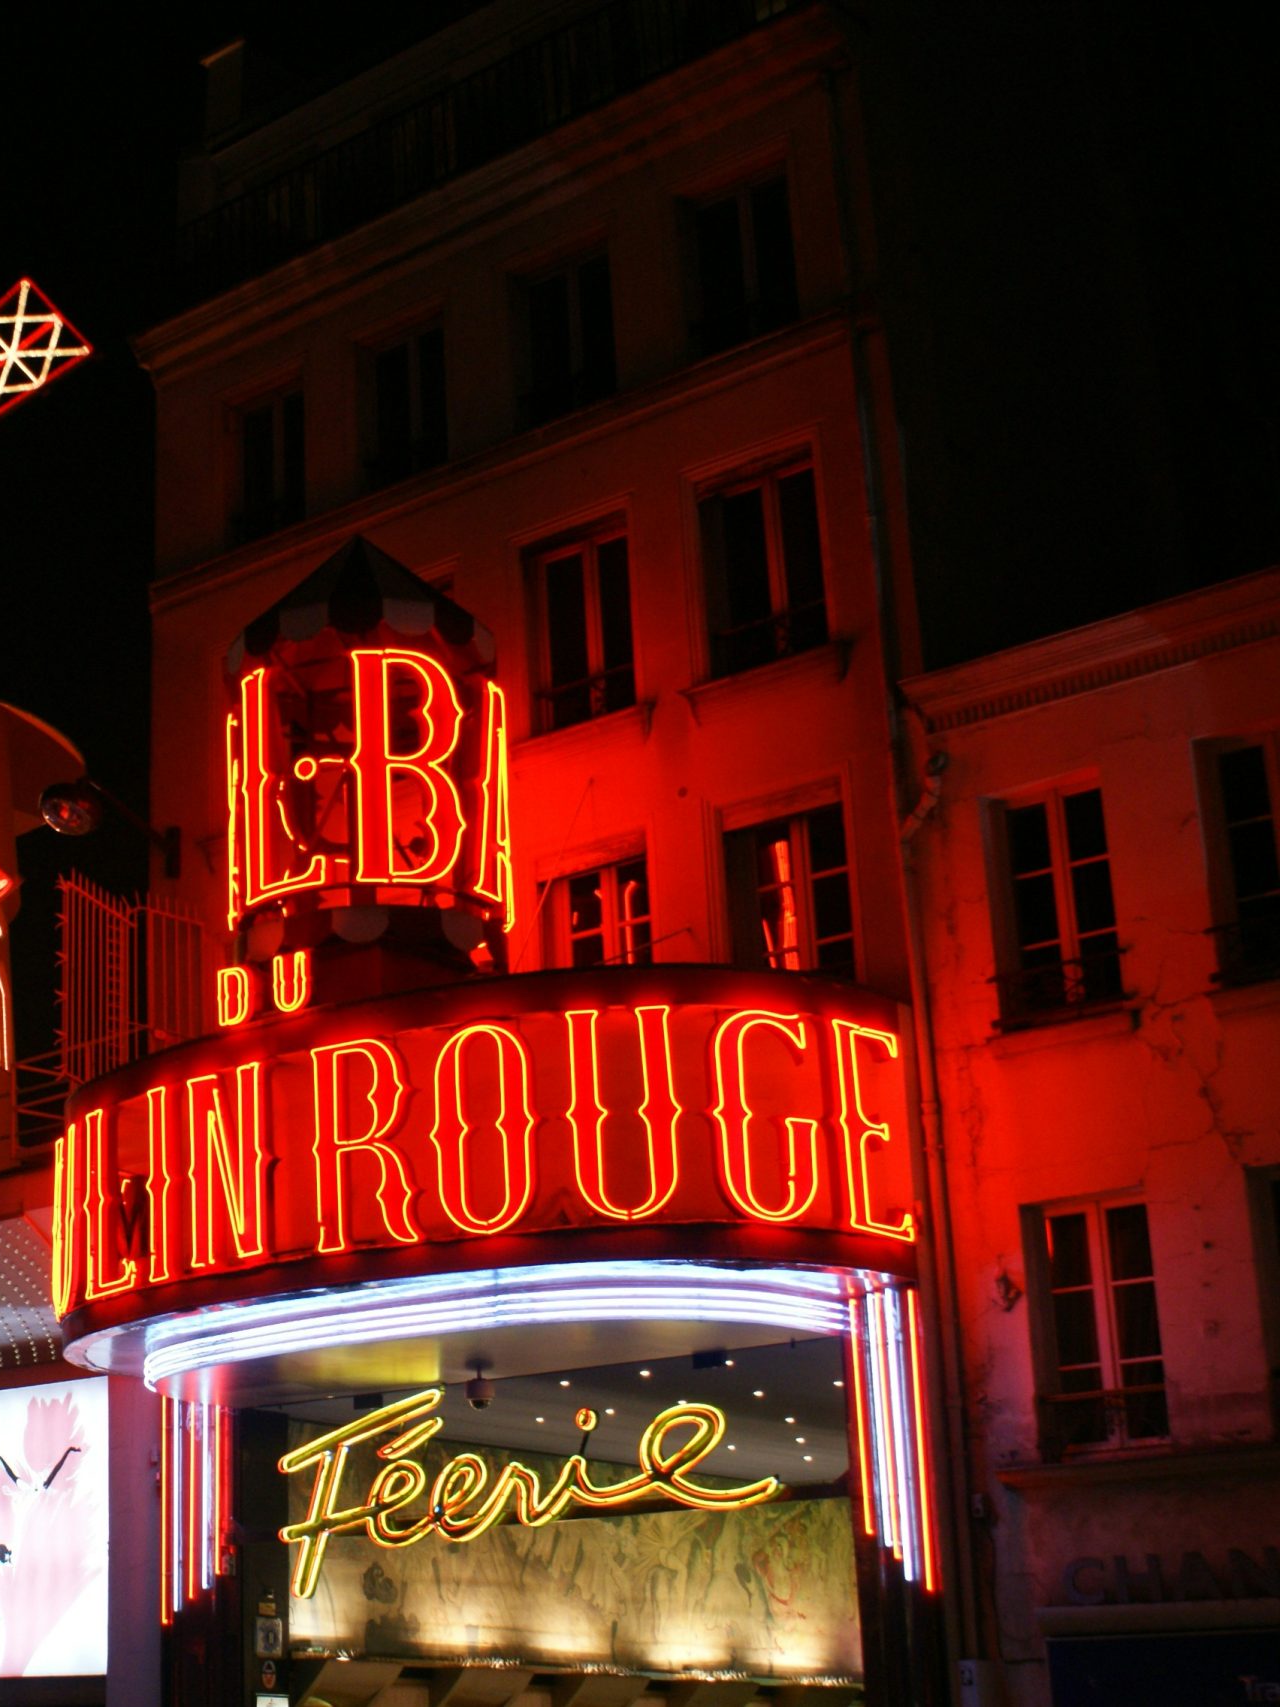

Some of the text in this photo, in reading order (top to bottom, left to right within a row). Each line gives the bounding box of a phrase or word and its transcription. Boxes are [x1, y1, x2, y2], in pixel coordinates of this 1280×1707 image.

[217, 951, 307, 1027] DU
[310, 1005, 915, 1254] ROUGE
[278, 1384, 781, 1599] Féerie
